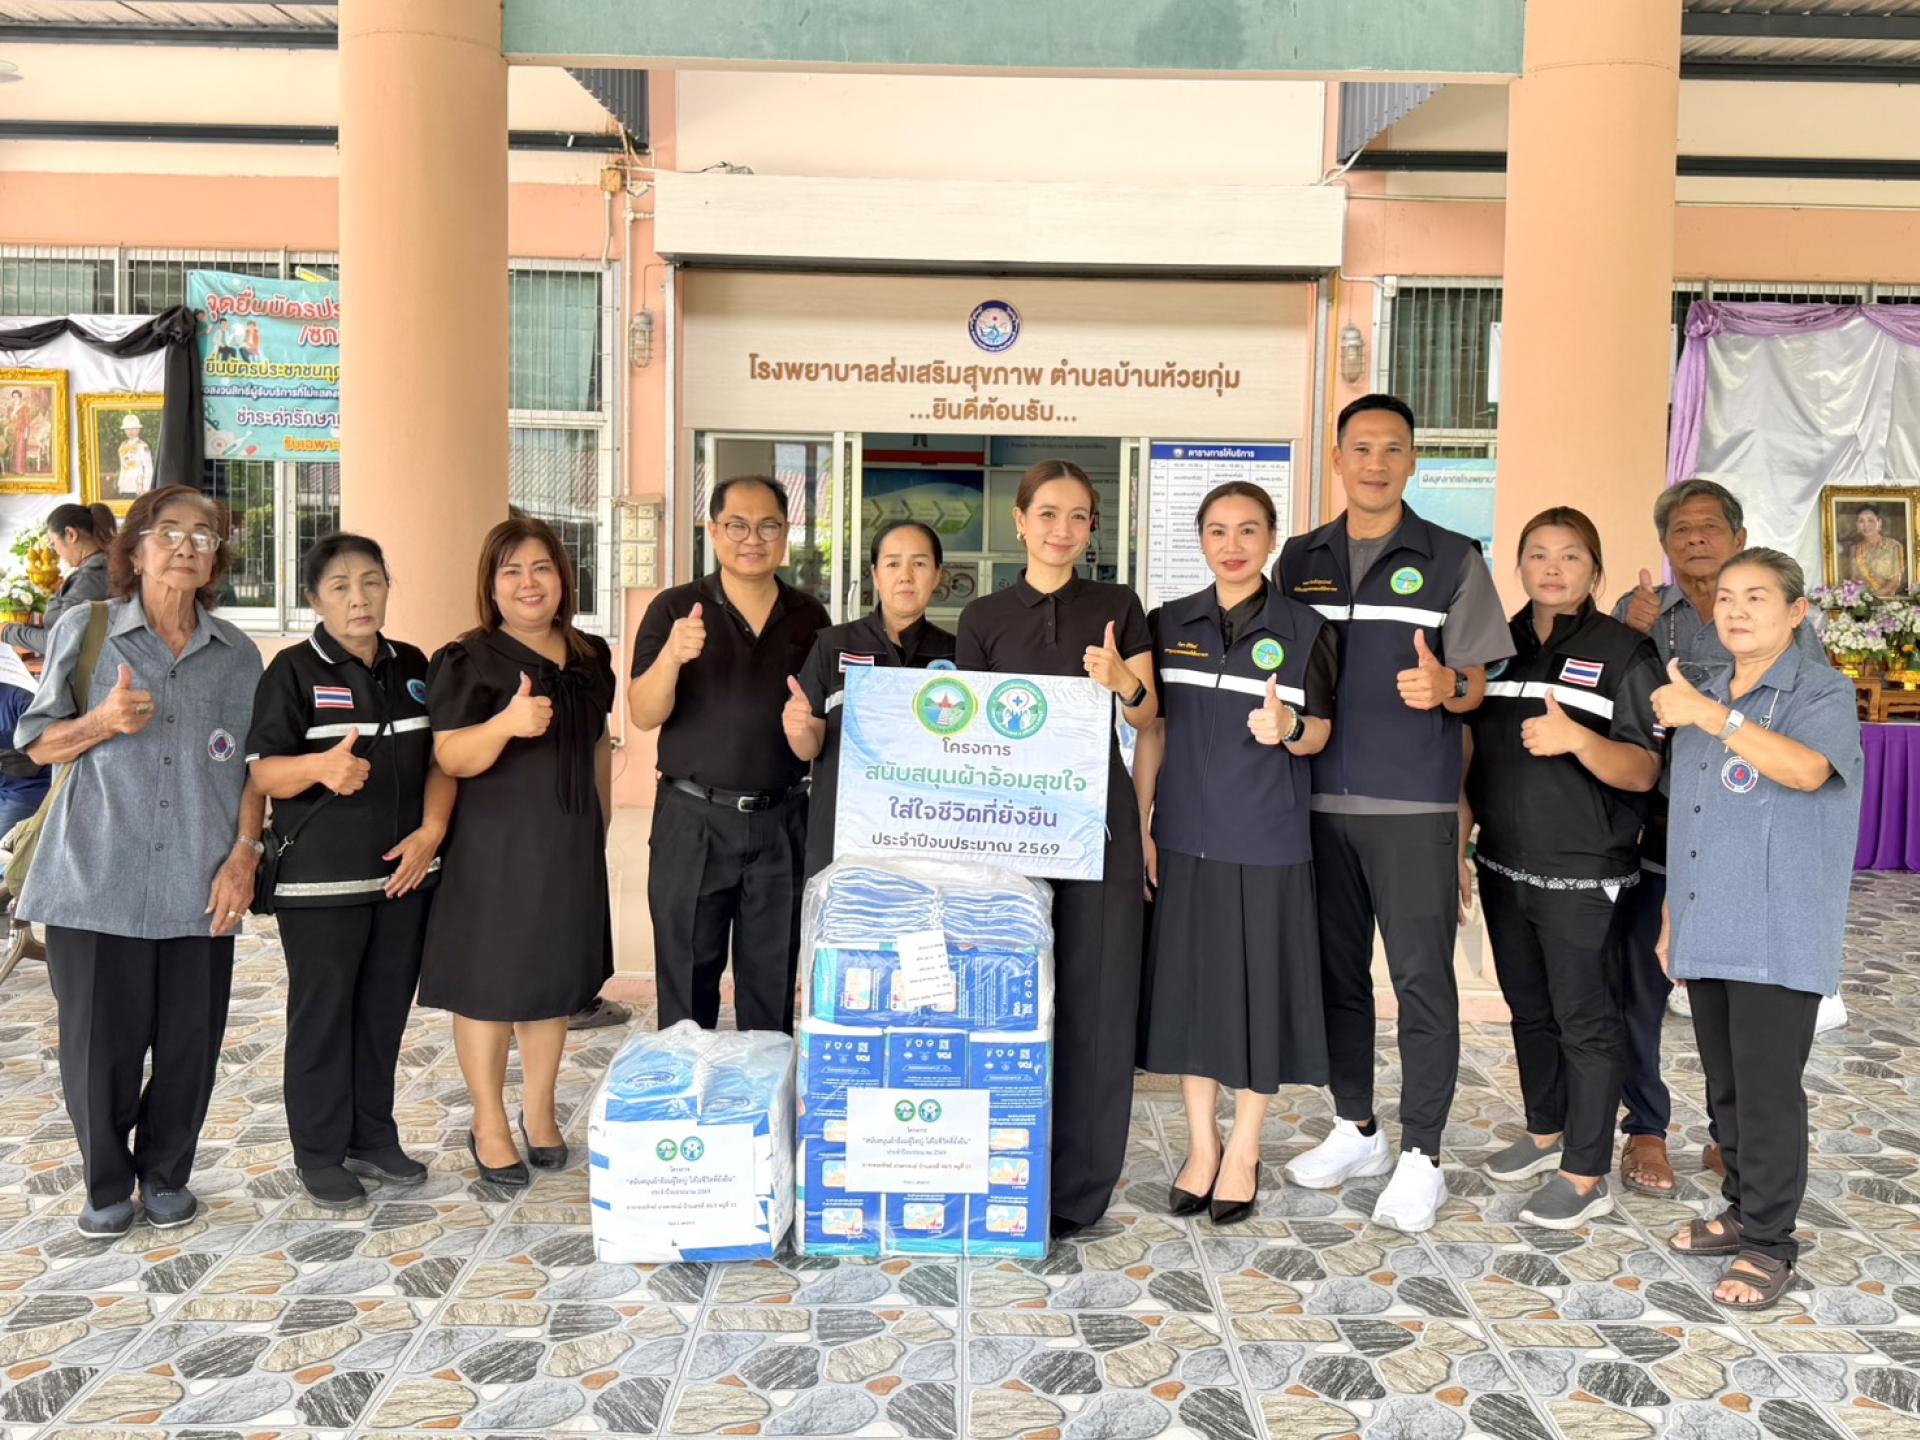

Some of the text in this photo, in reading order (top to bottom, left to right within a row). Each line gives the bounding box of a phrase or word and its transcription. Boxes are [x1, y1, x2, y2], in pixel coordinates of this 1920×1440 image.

[749, 353, 1241, 397] โรงพยาบาลส่งเสริมสุขภาพ ตำบลบ้านห้วยกุ่ม
[238, 407, 340, 425] ชำระค่ารักษา
[942, 737, 1011, 756] โครงการ
[865, 762, 1087, 795] สนับสนุนผ้าอ้อมสุขใจ
[889, 796, 1058, 828] ใส่ใจชีวิตที่ยั่งยืน
[872, 831, 1060, 855] ประจำปีงบประมาณ 2569
